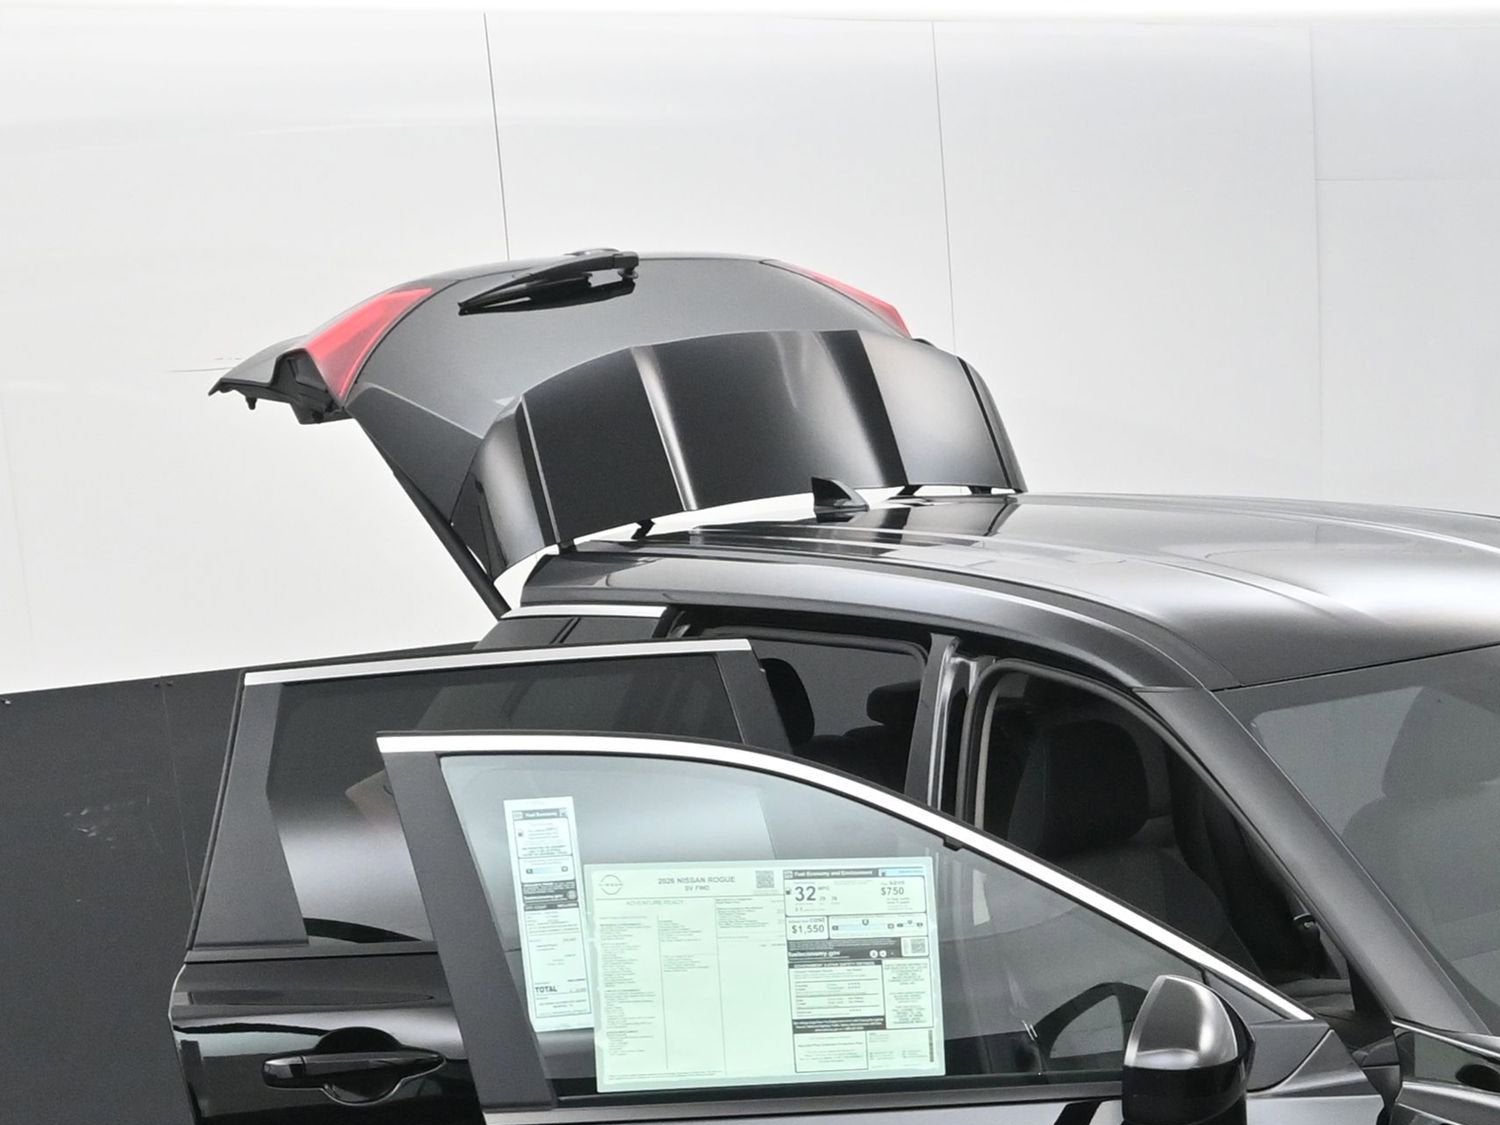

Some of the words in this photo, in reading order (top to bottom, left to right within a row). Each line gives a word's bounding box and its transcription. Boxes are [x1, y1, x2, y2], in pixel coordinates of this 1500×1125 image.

[677, 876, 706, 884] NISSAN
[794, 886, 817, 901] 32
[881, 886, 904, 896] $750
[791, 924, 825, 935] $1,550
[535, 985, 558, 993] TOTAL
